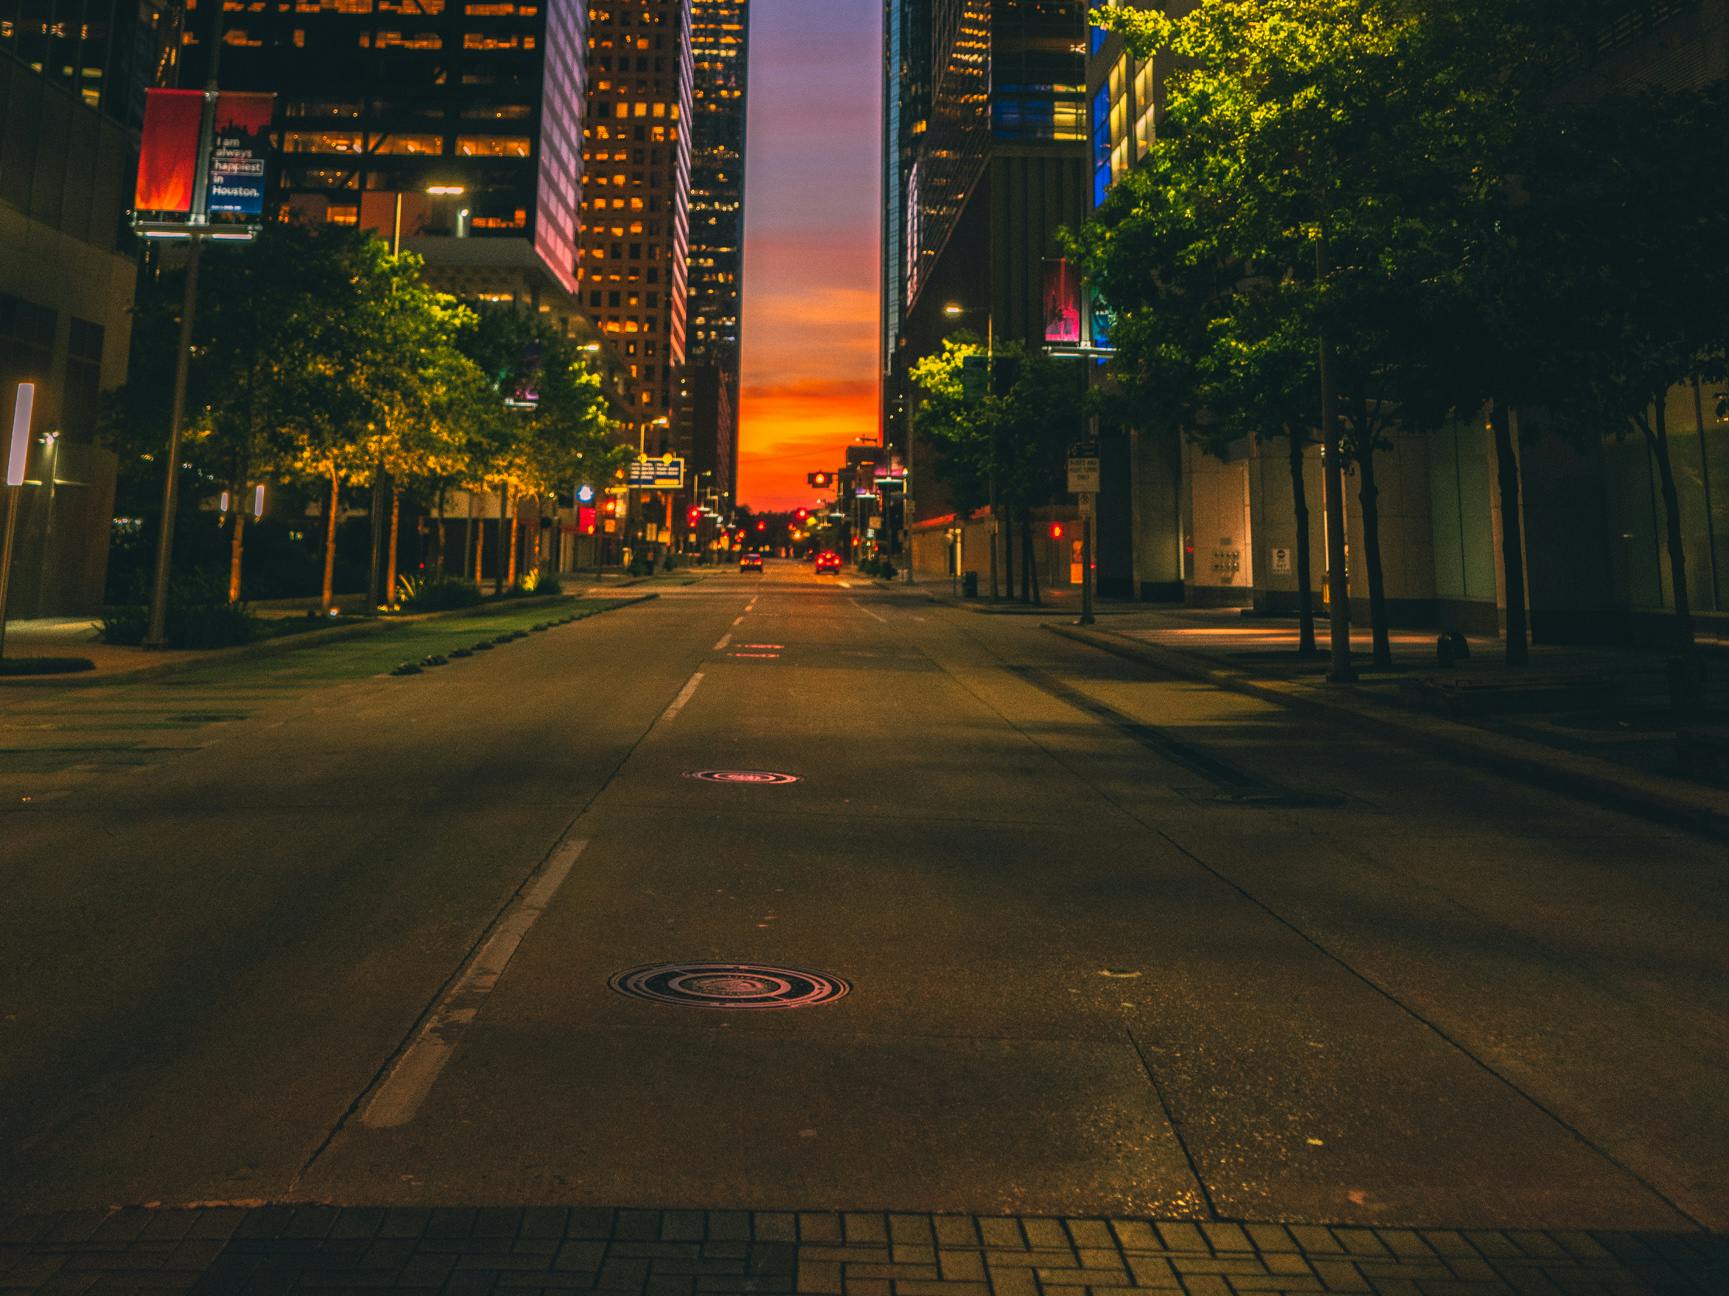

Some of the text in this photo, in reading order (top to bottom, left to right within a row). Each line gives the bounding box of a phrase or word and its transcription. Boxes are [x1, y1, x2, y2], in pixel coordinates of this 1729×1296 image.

[223, 138, 240, 147] am
[216, 147, 253, 159] always
[214, 159, 261, 173] happiest
[213, 173, 224, 184] in
[212, 185, 260, 198] Houston.
